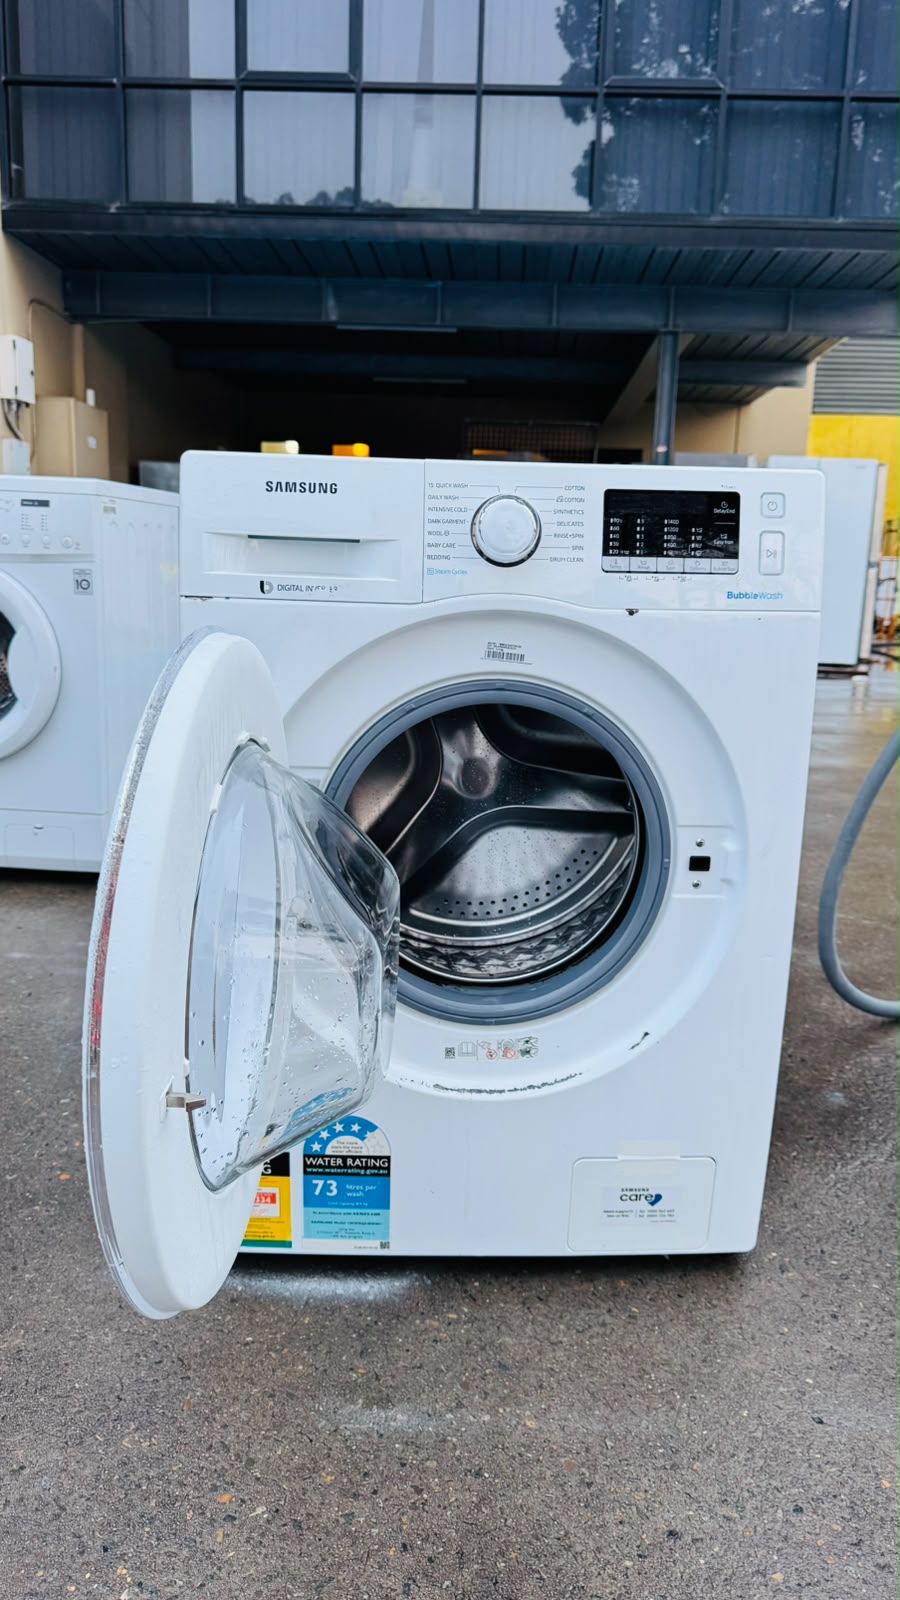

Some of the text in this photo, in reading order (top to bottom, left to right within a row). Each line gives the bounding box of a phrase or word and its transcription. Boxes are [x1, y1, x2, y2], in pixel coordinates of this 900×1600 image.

[265, 481, 338, 494] SAMSUNG
[75, 579, 91, 590] 10
[277, 584, 304, 592] DIGITAL
[727, 591, 783, 600] BubbleWash
[305, 1157, 389, 1167] WATER RATING
[312, 1180, 338, 1197] 73
[619, 1193, 654, 1202] care
